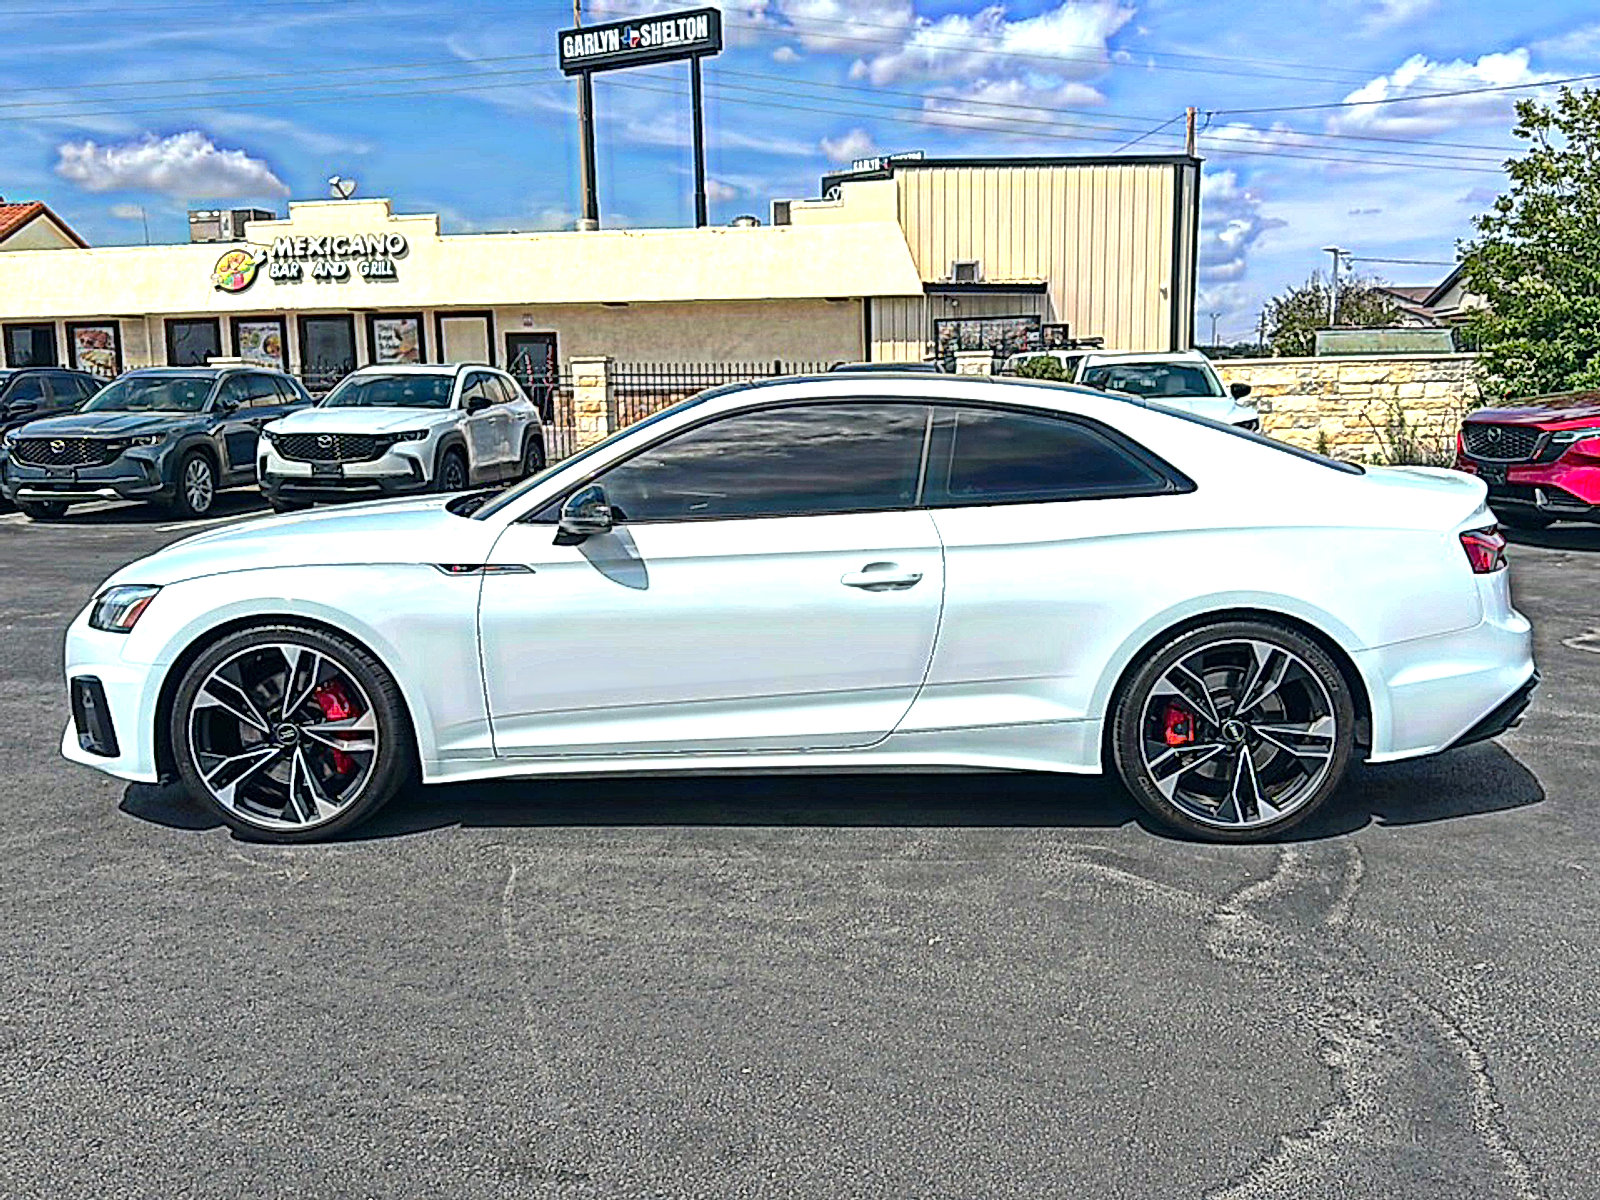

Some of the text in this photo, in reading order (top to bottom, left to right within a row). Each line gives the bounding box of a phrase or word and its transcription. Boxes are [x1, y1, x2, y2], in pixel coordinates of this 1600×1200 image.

[563, 14, 709, 58] GARLYN SHELTON
[271, 233, 407, 258] MEXICANO
[269, 259, 396, 279] BAR AND GRILL
